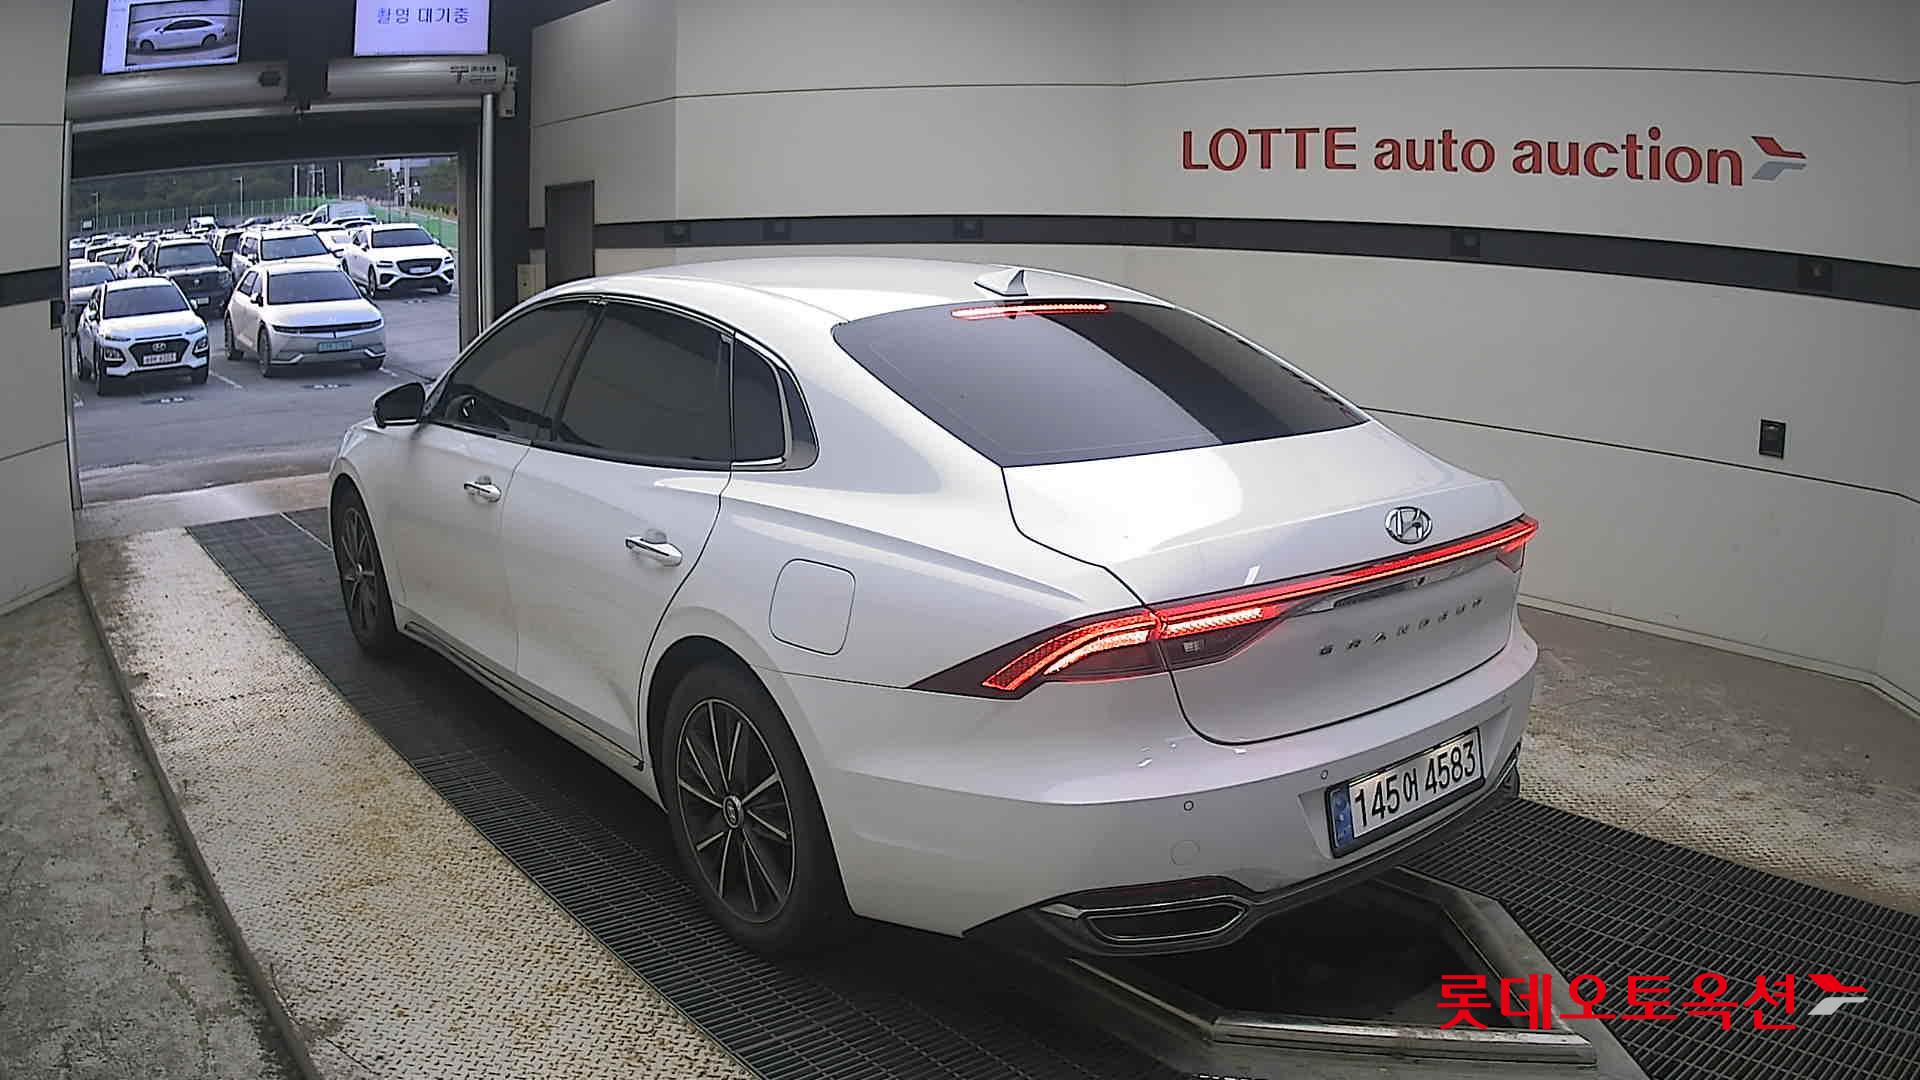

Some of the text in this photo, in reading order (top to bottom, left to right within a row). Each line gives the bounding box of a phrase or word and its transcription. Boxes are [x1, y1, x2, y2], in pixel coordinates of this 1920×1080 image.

[418, 7, 470, 24] 대기중
[1182, 126, 1743, 186] LOTTE auto auction
[1354, 740, 1476, 828] 145어 4583
